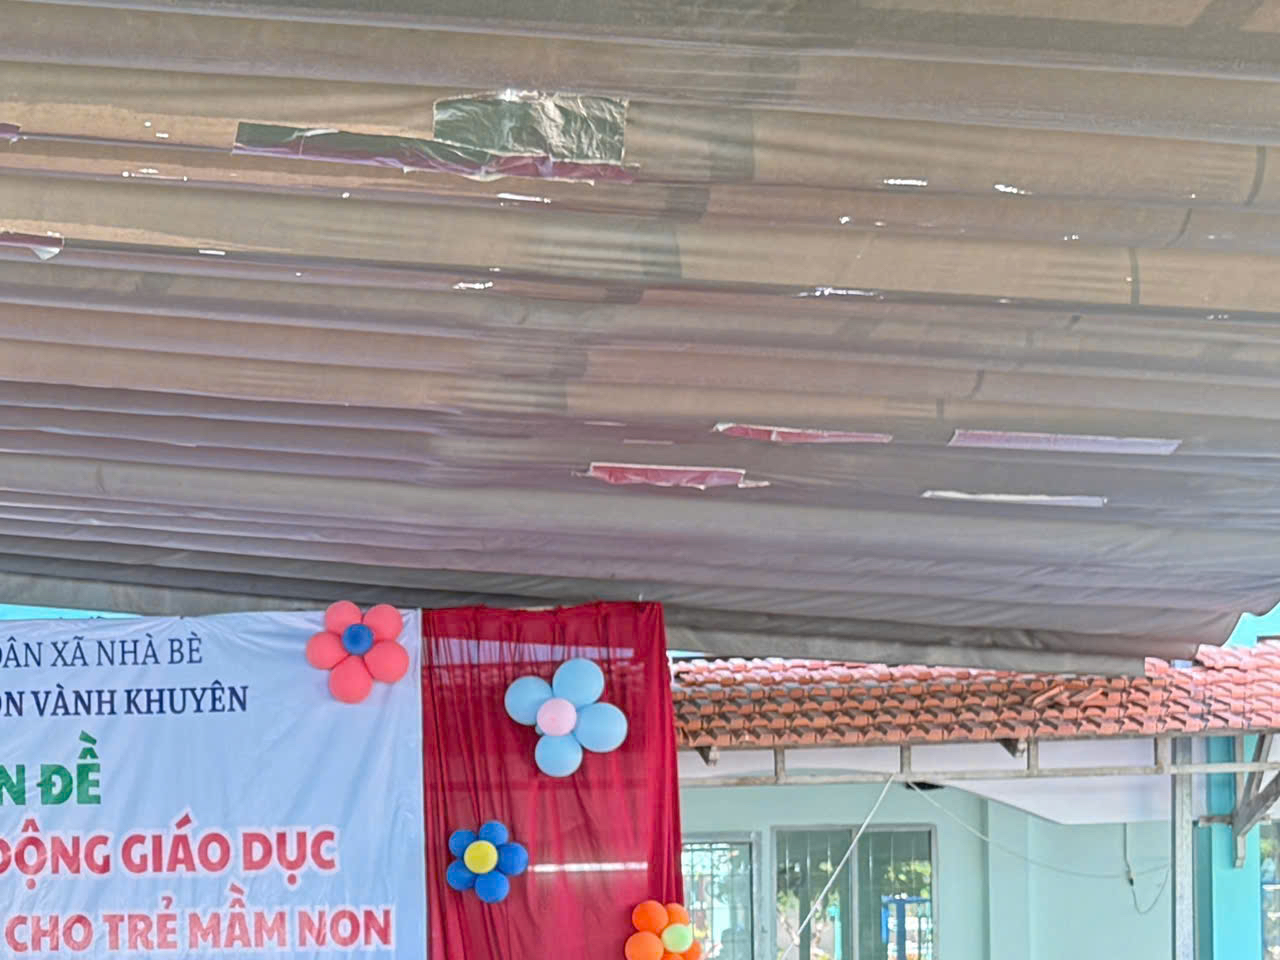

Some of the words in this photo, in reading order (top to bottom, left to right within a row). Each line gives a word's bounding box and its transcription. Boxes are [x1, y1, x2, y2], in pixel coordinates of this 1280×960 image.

[50, 635, 88, 668] XÃ
[96, 633, 160, 667] NHÀ
[168, 632, 203, 664] BÈ
[31, 684, 117, 717] VÀNH
[124, 680, 249, 715] KHUYÊN
[36, 730, 101, 805] ĐỀ
[121, 813, 230, 874] GIÁO
[242, 831, 336, 886] DỤC
[5, 914, 93, 952] CHO
[102, 895, 177, 951] TRẺ
[188, 883, 286, 949] MẦM
[297, 909, 392, 948] NON
